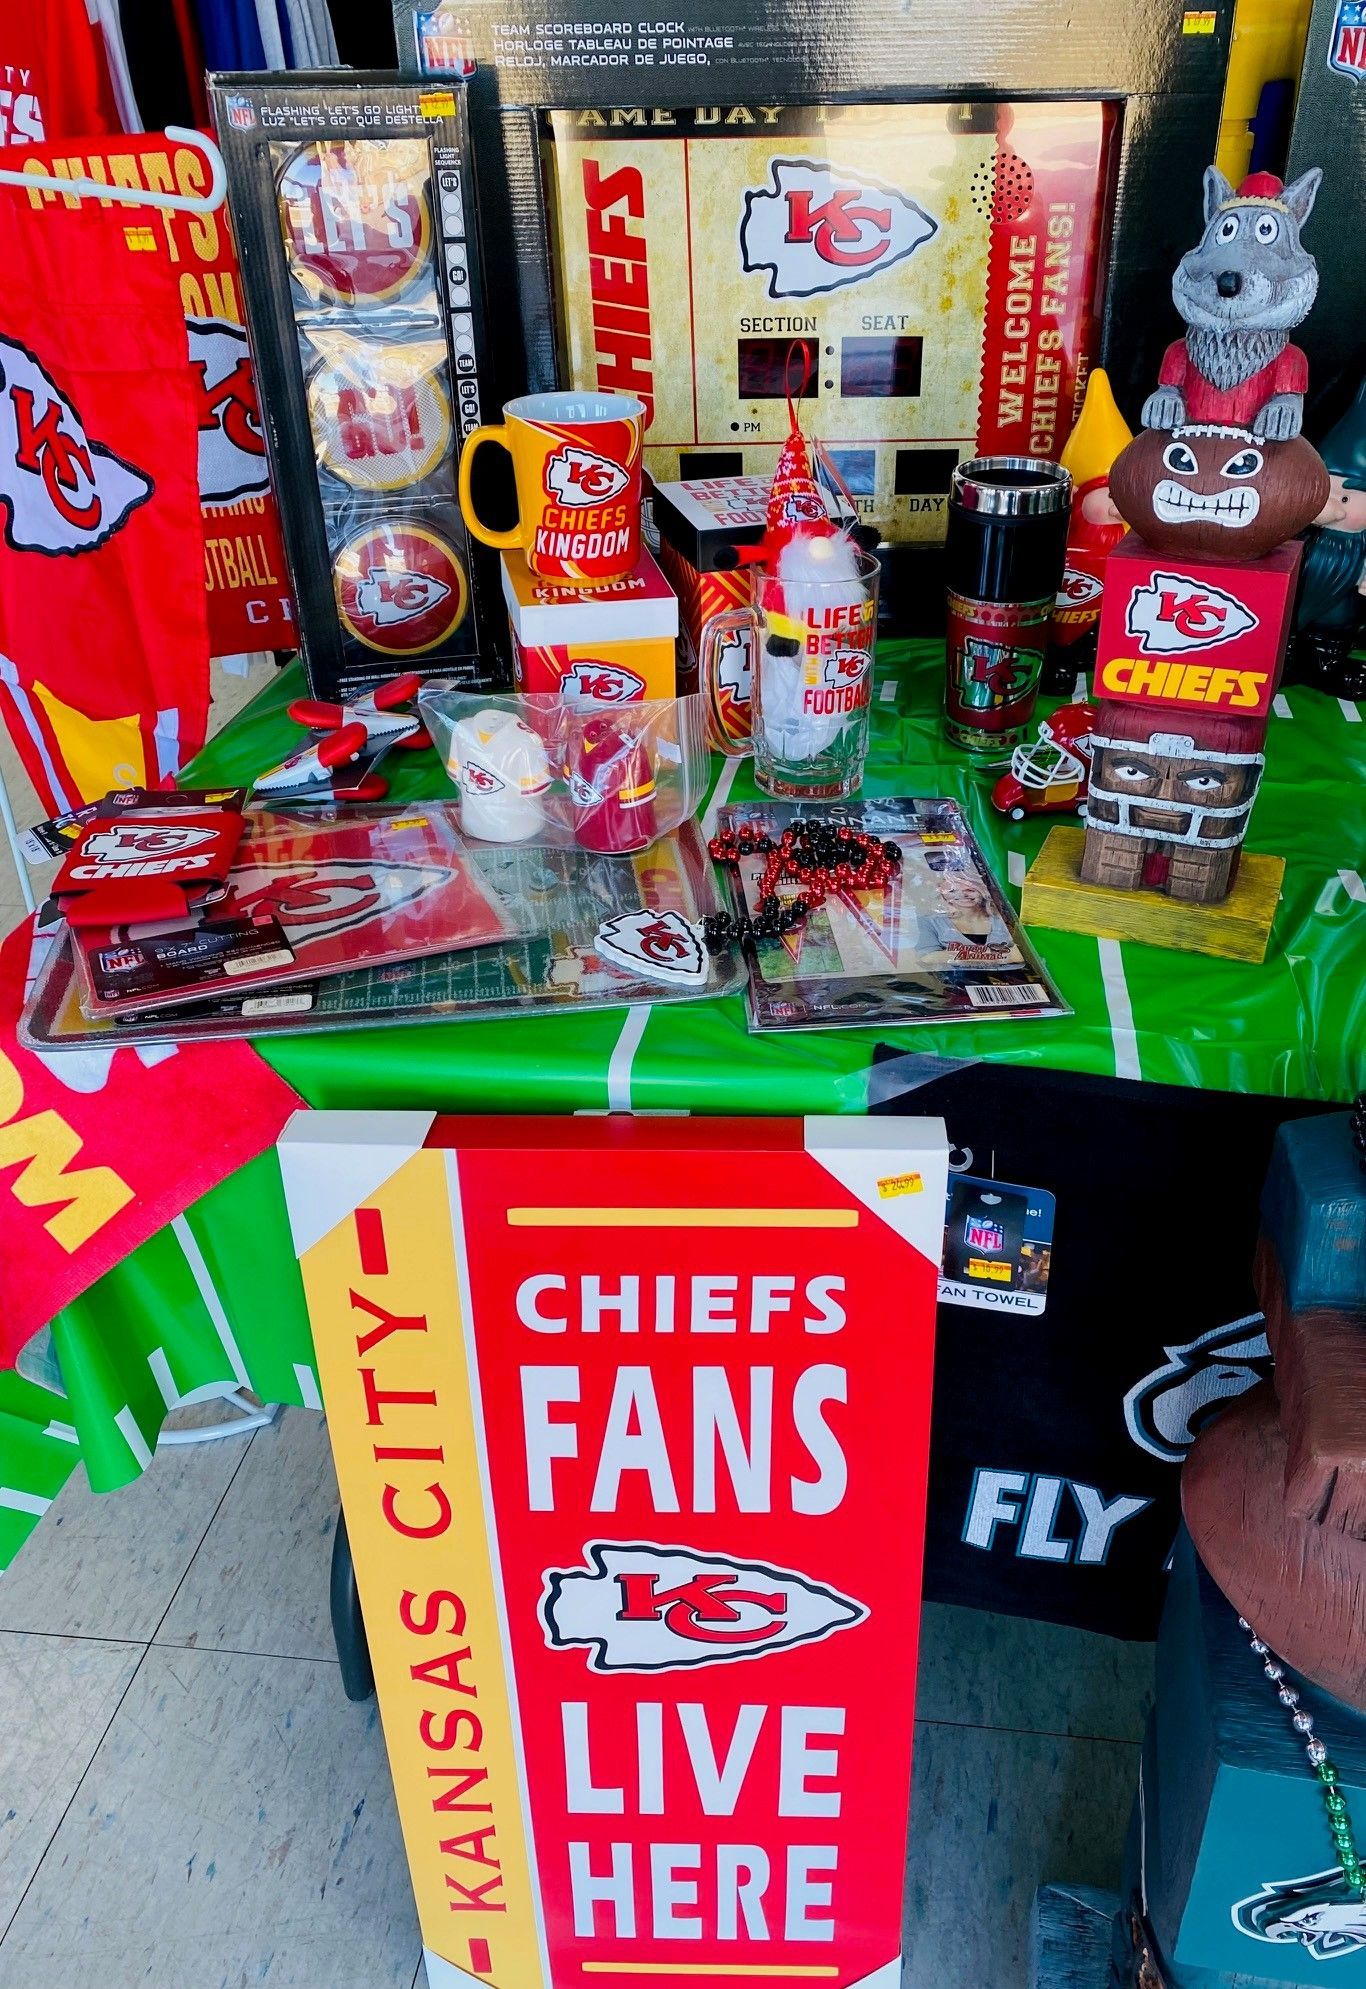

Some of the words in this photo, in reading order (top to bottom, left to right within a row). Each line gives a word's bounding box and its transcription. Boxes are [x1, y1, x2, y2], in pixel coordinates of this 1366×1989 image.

[492, 24, 530, 36] TEAM
[536, 22, 632, 35] SCOREBOARD
[638, 21, 685, 34] CLOCK
[493, 39, 563, 51] HORLOGE
[568, 38, 632, 50] TABLEAU
[638, 38, 657, 49] DE
[663, 36, 734, 49] POINTAGE
[495, 55, 546, 67] RELOJ,
[550, 54, 629, 67] MARCADOR
[635, 54, 654, 65] DE
[659, 53, 711, 66] JUEGO,
[231, 107, 257, 124] NFL
[260, 105, 320, 117] FLASHING
[385, 104, 421, 115] LIGHT
[262, 117, 286, 127] LUZ
[356, 115, 381, 128] QUE
[385, 114, 444, 125] DESTELLA
[442, 177, 458, 187] LET'S
[784, 189, 893, 267] KC
[1040, 202, 1076, 316] FANS!
[452, 270, 464, 281] GO!
[582, 158, 654, 430] HIEFS
[740, 316, 818, 333] SECTION
[861, 314, 909, 331] SEAT
[997, 234, 1038, 429] WELCOME
[458, 359, 473, 368] TEAM
[461, 385, 475, 394] LET'S
[1029, 328, 1065, 454] CHIEFS
[1071, 352, 1090, 422] TICKET
[464, 404, 475, 414] GO!
[743, 421, 761, 433] PM
[9, 383, 102, 532] KC
[567, 461, 615, 497] KC
[680, 478, 755, 491] LIFE
[689, 486, 773, 501] BETTE
[909, 497, 945, 512] DAY
[545, 504, 627, 531] CHIEFS
[536, 526, 631, 560] KINGDOM
[204, 534, 279, 592] TBALL
[377, 579, 429, 611] KC
[535, 577, 646, 599] KINGDOM
[807, 604, 862, 629] LIFE
[1052, 608, 1101, 624] HIEFS
[1157, 591, 1228, 639] KC
[805, 623, 873, 655] BETTER
[837, 655, 865, 678] KC
[972, 655, 1034, 695] KC
[1102, 658, 1269, 707] CHIEFS
[468, 768, 494, 791] KC
[117, 831, 188, 851] KC
[69, 853, 217, 880] CHIEFS
[198, 928, 260, 945] CUTTING
[635, 920, 691, 963] KC
[107, 953, 145, 970] NFL
[156, 944, 208, 960] BOARD
[813, 1002, 871, 1011] NFL.COM
[969, 1227, 1003, 1250] NFL
[515, 1273, 847, 1334] CHIEFS
[972, 1289, 1039, 1310] TOWEL
[348, 1286, 453, 1540] CITY
[519, 1363, 849, 1516] FANS
[961, 1467, 1154, 1565] FLY
[614, 1573, 787, 1643] KC
[399, 1588, 507, 1915] KANSAS
[561, 1700, 845, 1818] LIVE
[567, 1840, 839, 1943] HERE
